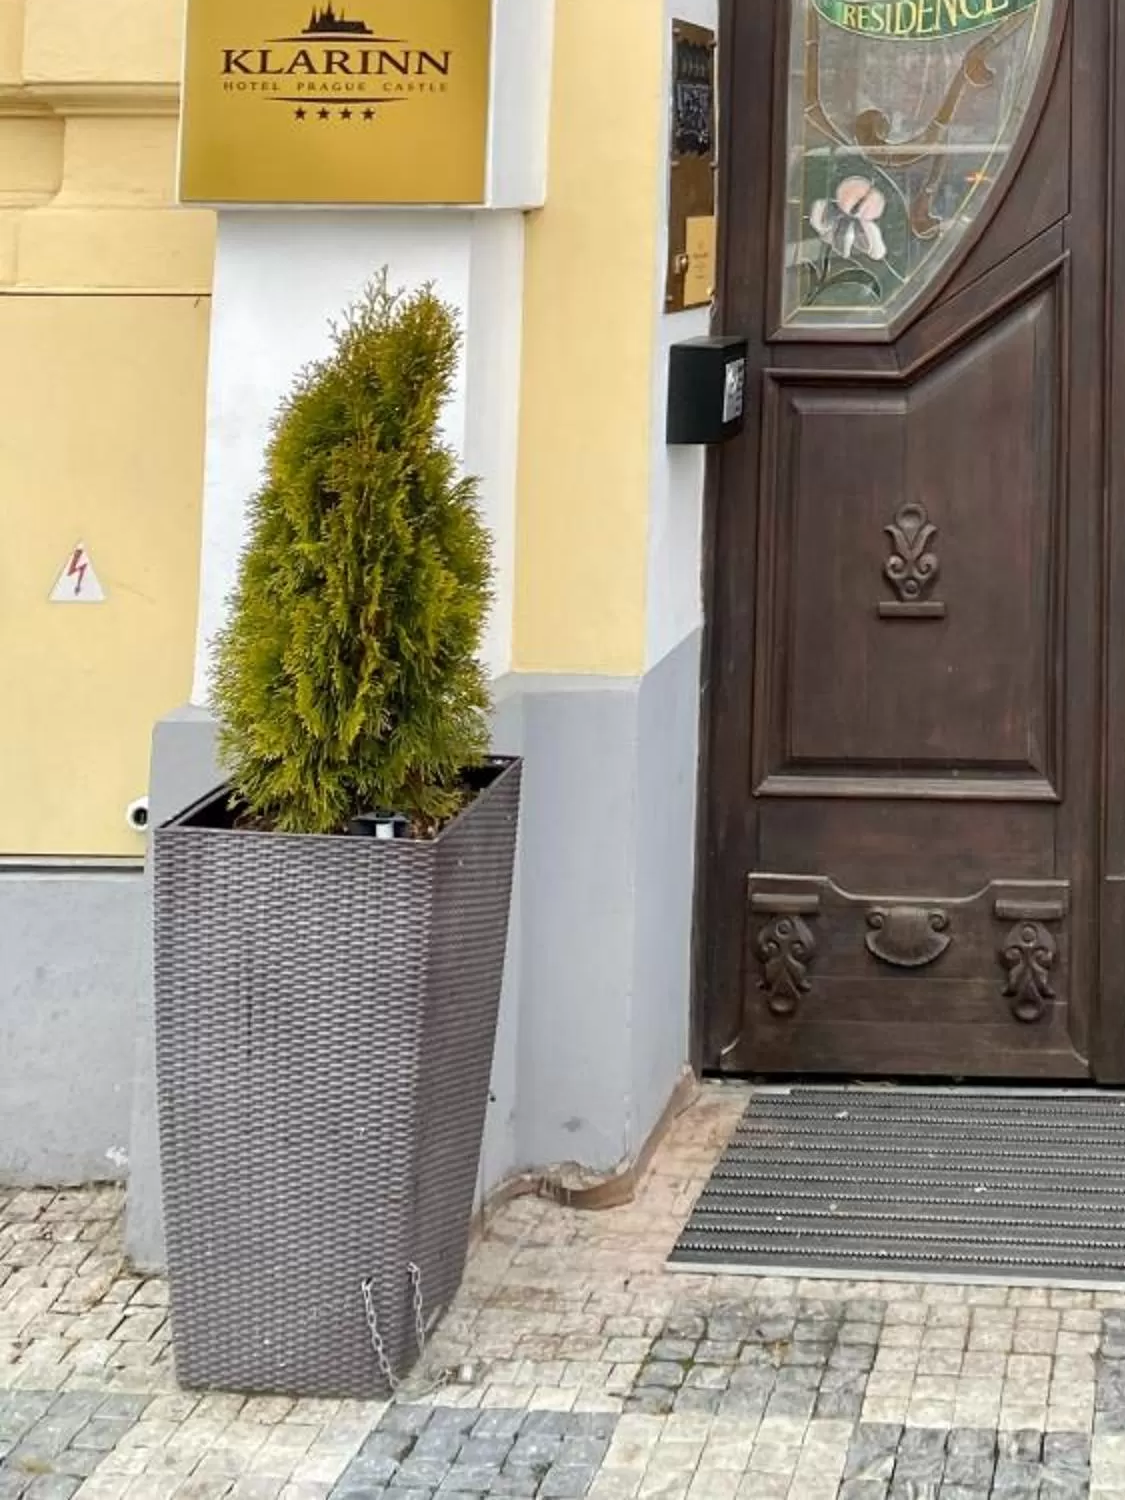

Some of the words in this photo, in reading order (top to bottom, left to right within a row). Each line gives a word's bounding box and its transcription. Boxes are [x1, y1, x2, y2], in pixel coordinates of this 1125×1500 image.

[221, 49, 451, 75] KLARINN
[223, 81, 281, 92] HOTEL
[296, 82, 367, 92] PRAGUE
[383, 82, 449, 93] CASTLE
